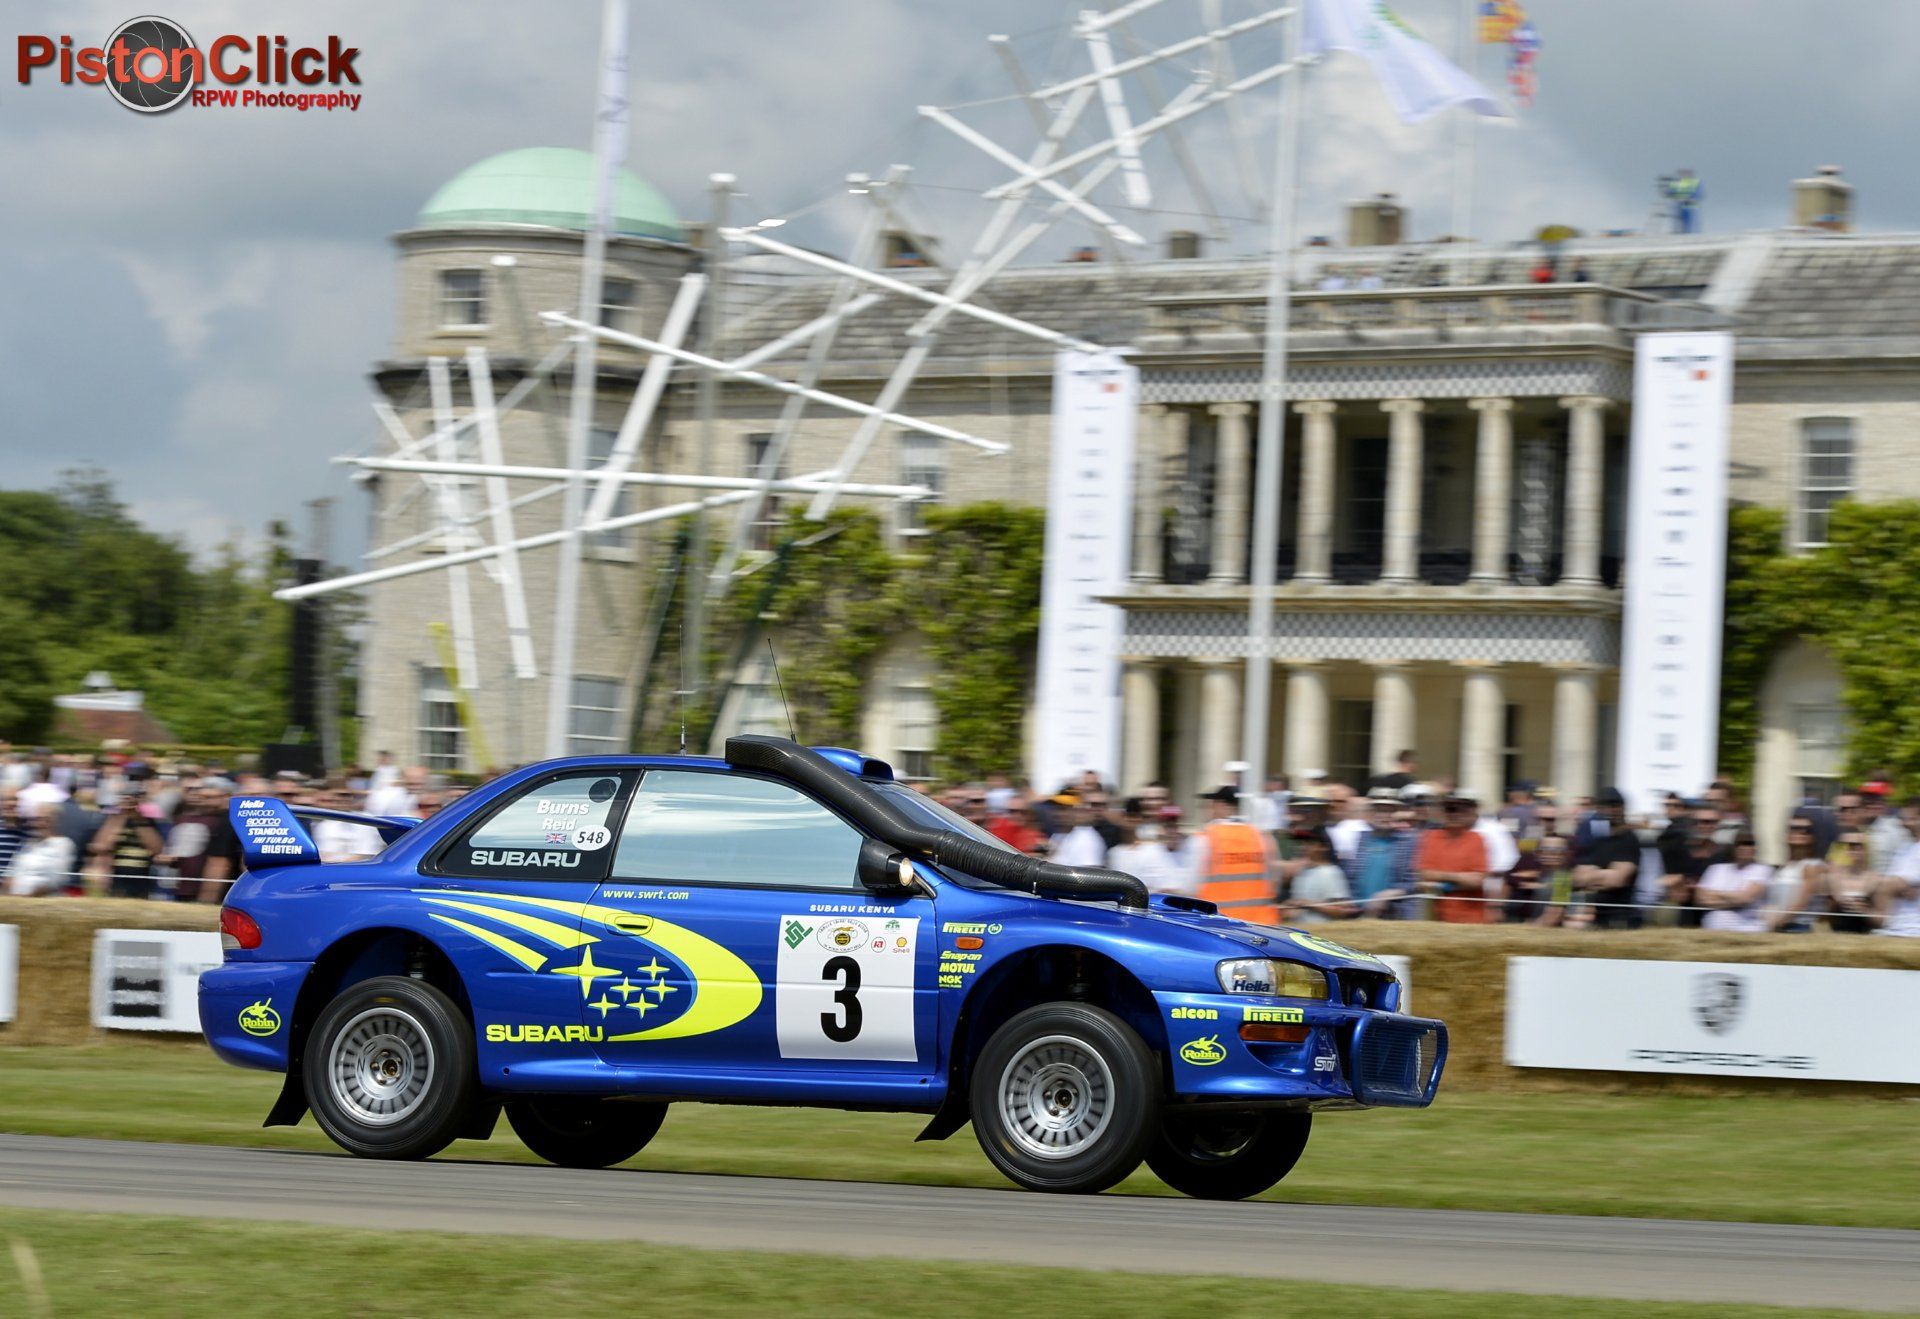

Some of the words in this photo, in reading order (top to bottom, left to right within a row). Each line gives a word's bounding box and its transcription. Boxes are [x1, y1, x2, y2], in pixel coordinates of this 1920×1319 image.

[240, 800, 264, 808] Hella
[536, 799, 590, 816] Burns
[542, 818, 576, 831] Reid
[577, 831, 604, 844] 548
[262, 845, 302, 854] BILSTEIN
[470, 850, 581, 867] SUBARU
[602, 889, 689, 900] www.swrt.com
[809, 904, 855, 913] SUBARU
[858, 905, 895, 914] KENYA
[942, 922, 987, 934] PIRELLI
[940, 951, 982, 962] Snap-on
[939, 962, 976, 974] MOTUL
[938, 975, 963, 984] NGK
[1232, 979, 1271, 993] Hella
[820, 955, 863, 1043] 3
[1171, 1007, 1218, 1020] alcon
[1243, 1006, 1304, 1023] PIRELLI
[242, 1017, 275, 1029] Robin
[486, 1024, 603, 1042] SUBARU
[1184, 1049, 1221, 1060] Robin
